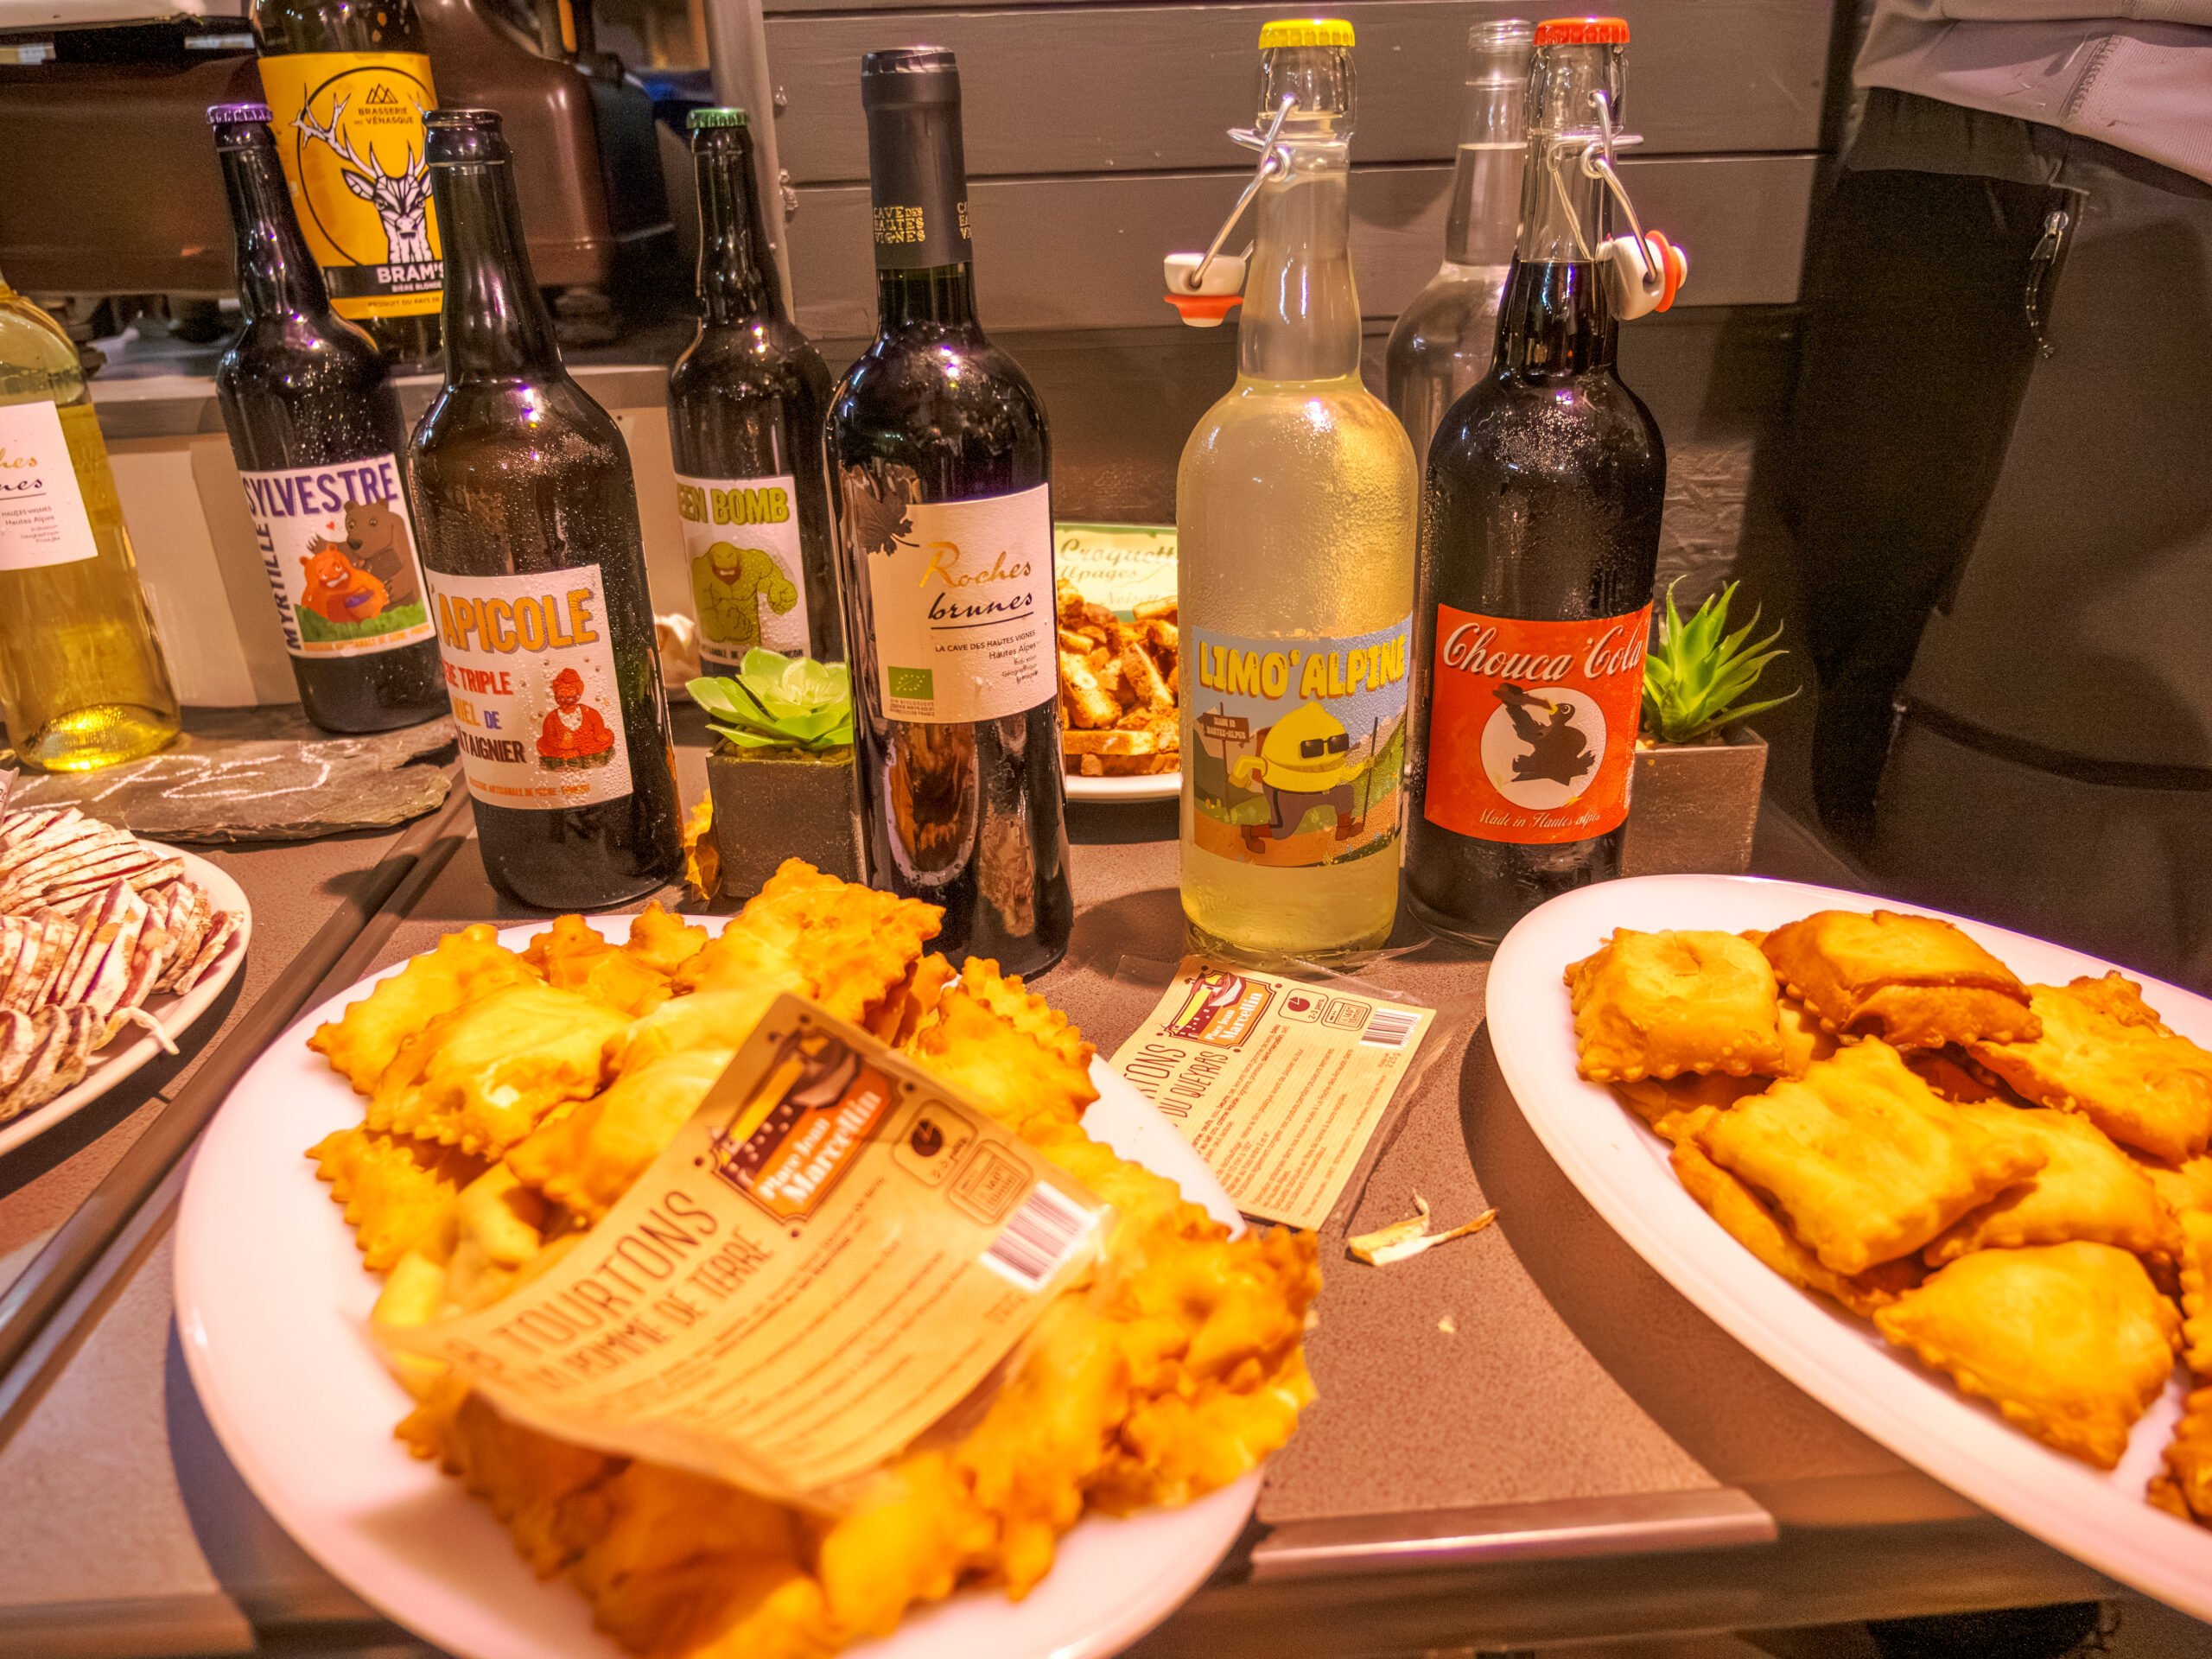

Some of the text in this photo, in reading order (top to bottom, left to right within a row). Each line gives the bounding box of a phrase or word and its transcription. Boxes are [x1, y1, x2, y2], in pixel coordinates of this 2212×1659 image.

[358, 106, 408, 117] BRASSERIE
[874, 217, 925, 232] HAUTES
[874, 230, 925, 244] VIGNES
[242, 462, 397, 517] SYLVESTRE
[710, 486, 790, 525] BOMB
[919, 541, 1032, 588] Roches
[928, 592, 1033, 621] brunes
[947, 644, 968, 652] CAVE
[970, 642, 985, 651] DES
[987, 636, 1014, 649] HAUTES
[1015, 630, 1036, 641] VIGNES
[988, 642, 1037, 659] Hautes Alpes
[1443, 622, 1574, 682] Chouca
[459, 666, 514, 696] TRIPLE
[1199, 633, 1407, 701] LIMO'ALPINE
[483, 710, 502, 730] DE
[1512, 816, 1527, 828] in
[1203, 1009, 1236, 1040] Place Jean
[1218, 992, 1262, 1038] Marcellin
[1306, 997, 1327, 1020] 2-3 pers.
[1170, 1051, 1228, 1098] QUEYRAS
[782, 1090, 882, 1205] Marcellin
[758, 1150, 796, 1200] Place
[493, 1190, 718, 1354] TOURTONS
[687, 1224, 775, 1299] TERRE
